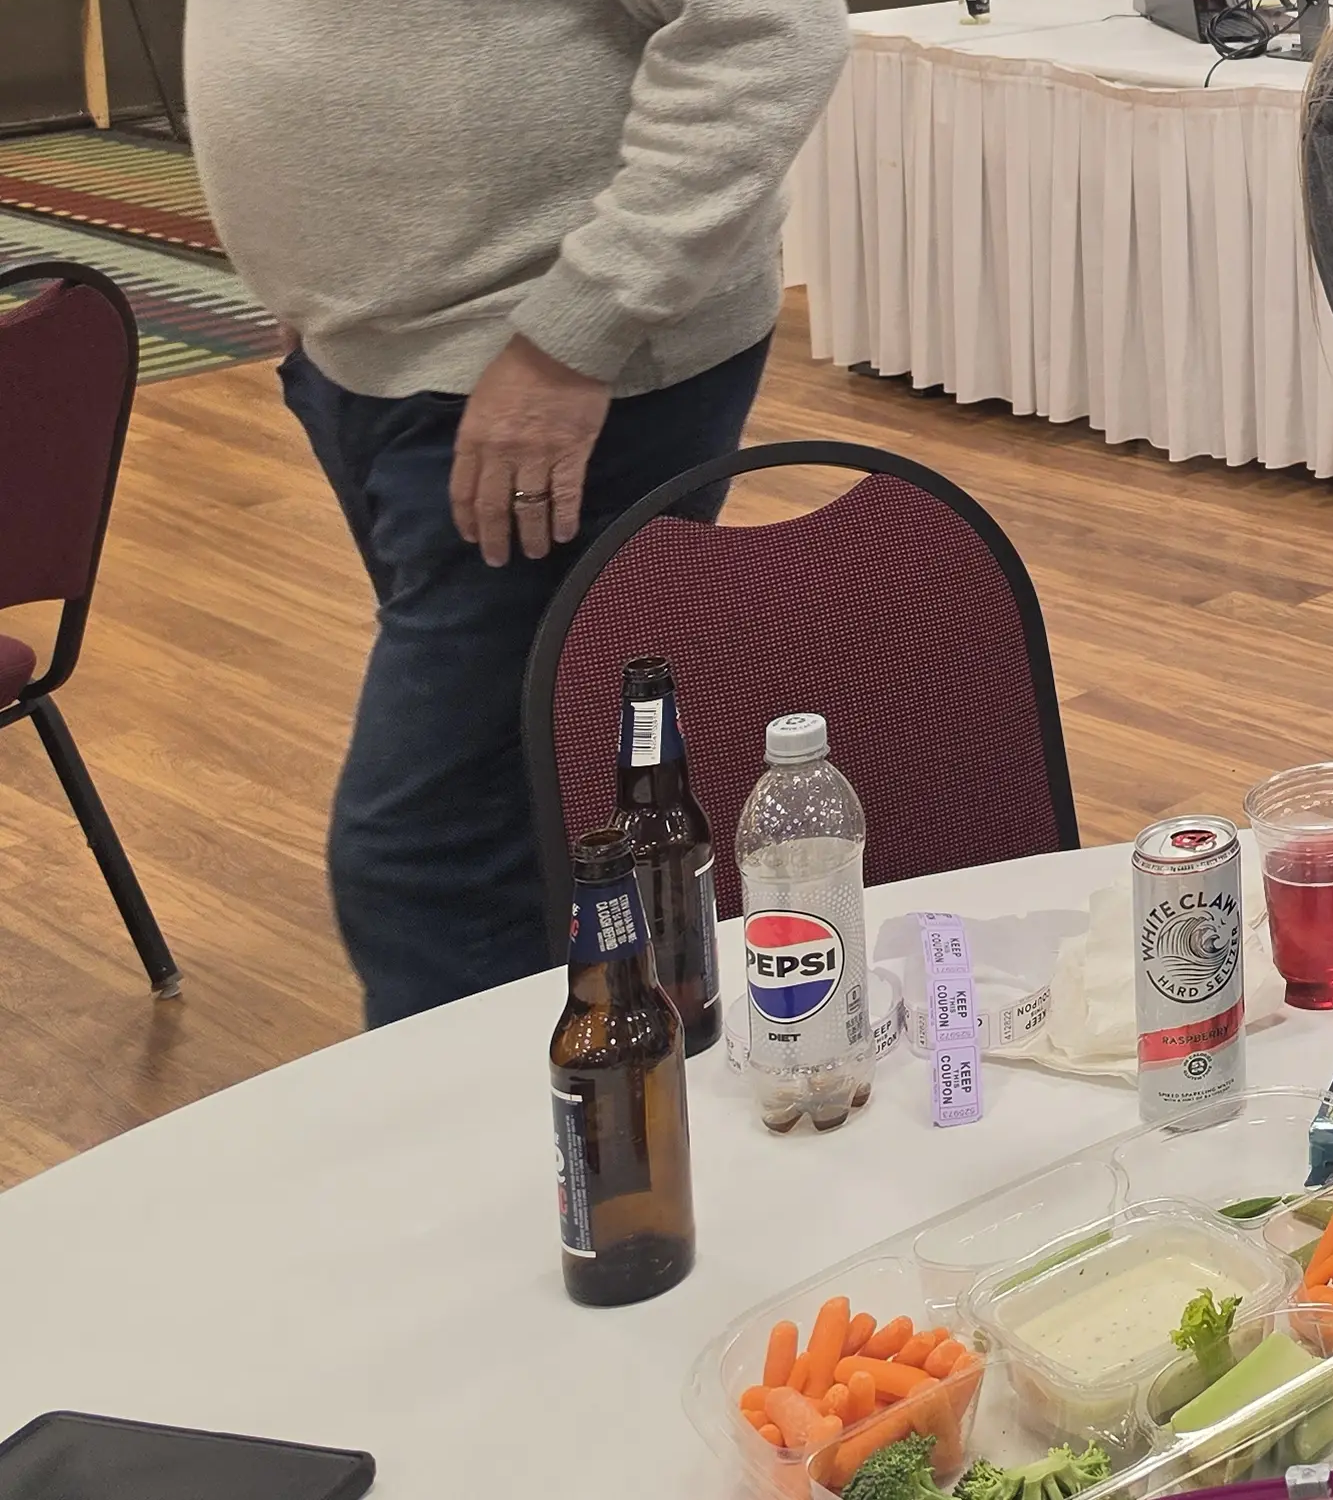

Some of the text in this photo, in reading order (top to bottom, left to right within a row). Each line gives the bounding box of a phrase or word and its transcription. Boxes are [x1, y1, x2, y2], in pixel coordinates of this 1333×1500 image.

[1141, 892, 1238, 962] WHITE CLAW
[746, 947, 836, 978] PEPSI
[931, 932, 944, 963] COUPON
[950, 937, 962, 958] KEEP
[1157, 925, 1238, 998] HARD SELTZER
[937, 984, 949, 1028] COUPON
[956, 990, 968, 1018] KEEP
[768, 1032, 801, 1042] DIET
[874, 1021, 892, 1038] EEP
[876, 1033, 889, 1044] HIS
[1162, 1024, 1229, 1045] RASPBERRY
[940, 1054, 953, 1105] COUPON
[960, 1061, 972, 1093] KEEP
